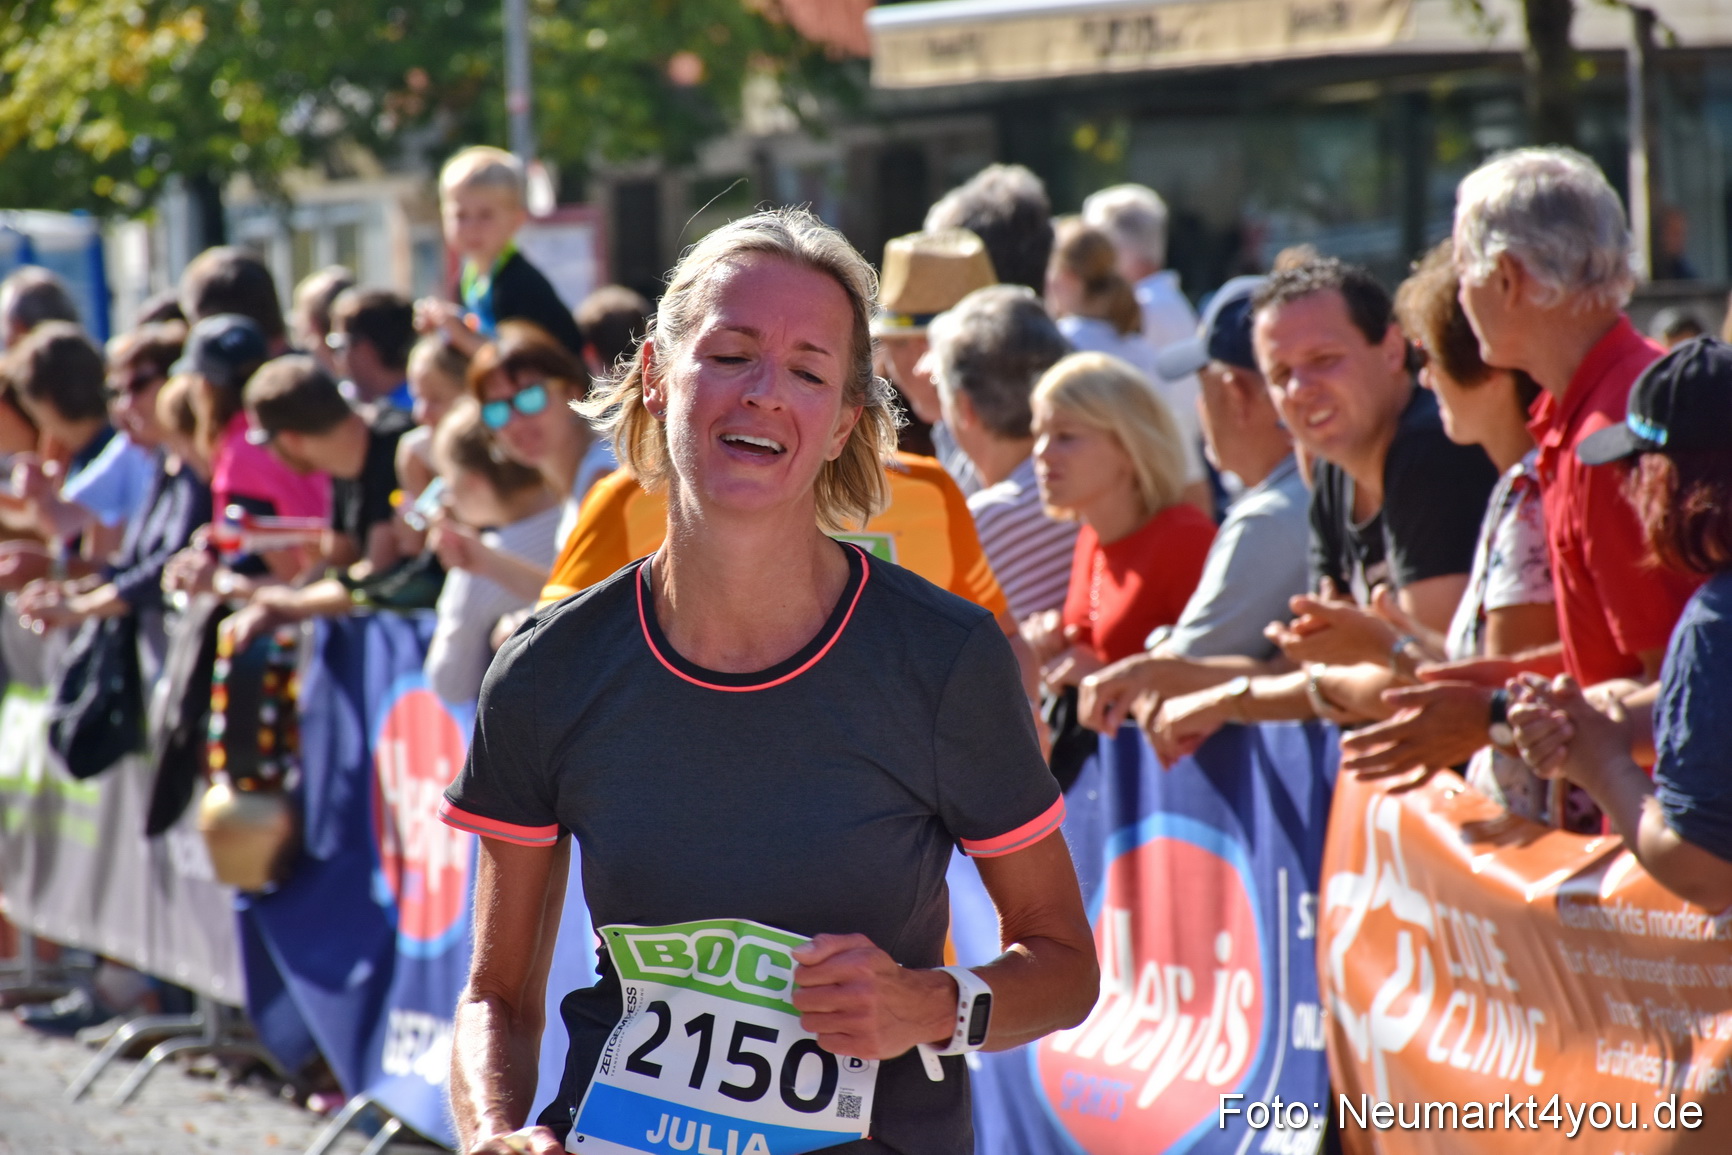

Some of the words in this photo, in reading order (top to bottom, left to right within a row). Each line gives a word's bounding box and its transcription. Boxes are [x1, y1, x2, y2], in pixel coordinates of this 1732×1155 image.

[630, 932, 795, 996] BOC
[1435, 902, 1518, 992] CODE
[625, 1000, 839, 1114] 2150
[1426, 991, 1546, 1086] CLINIC
[646, 1114, 771, 1155] JULIA
